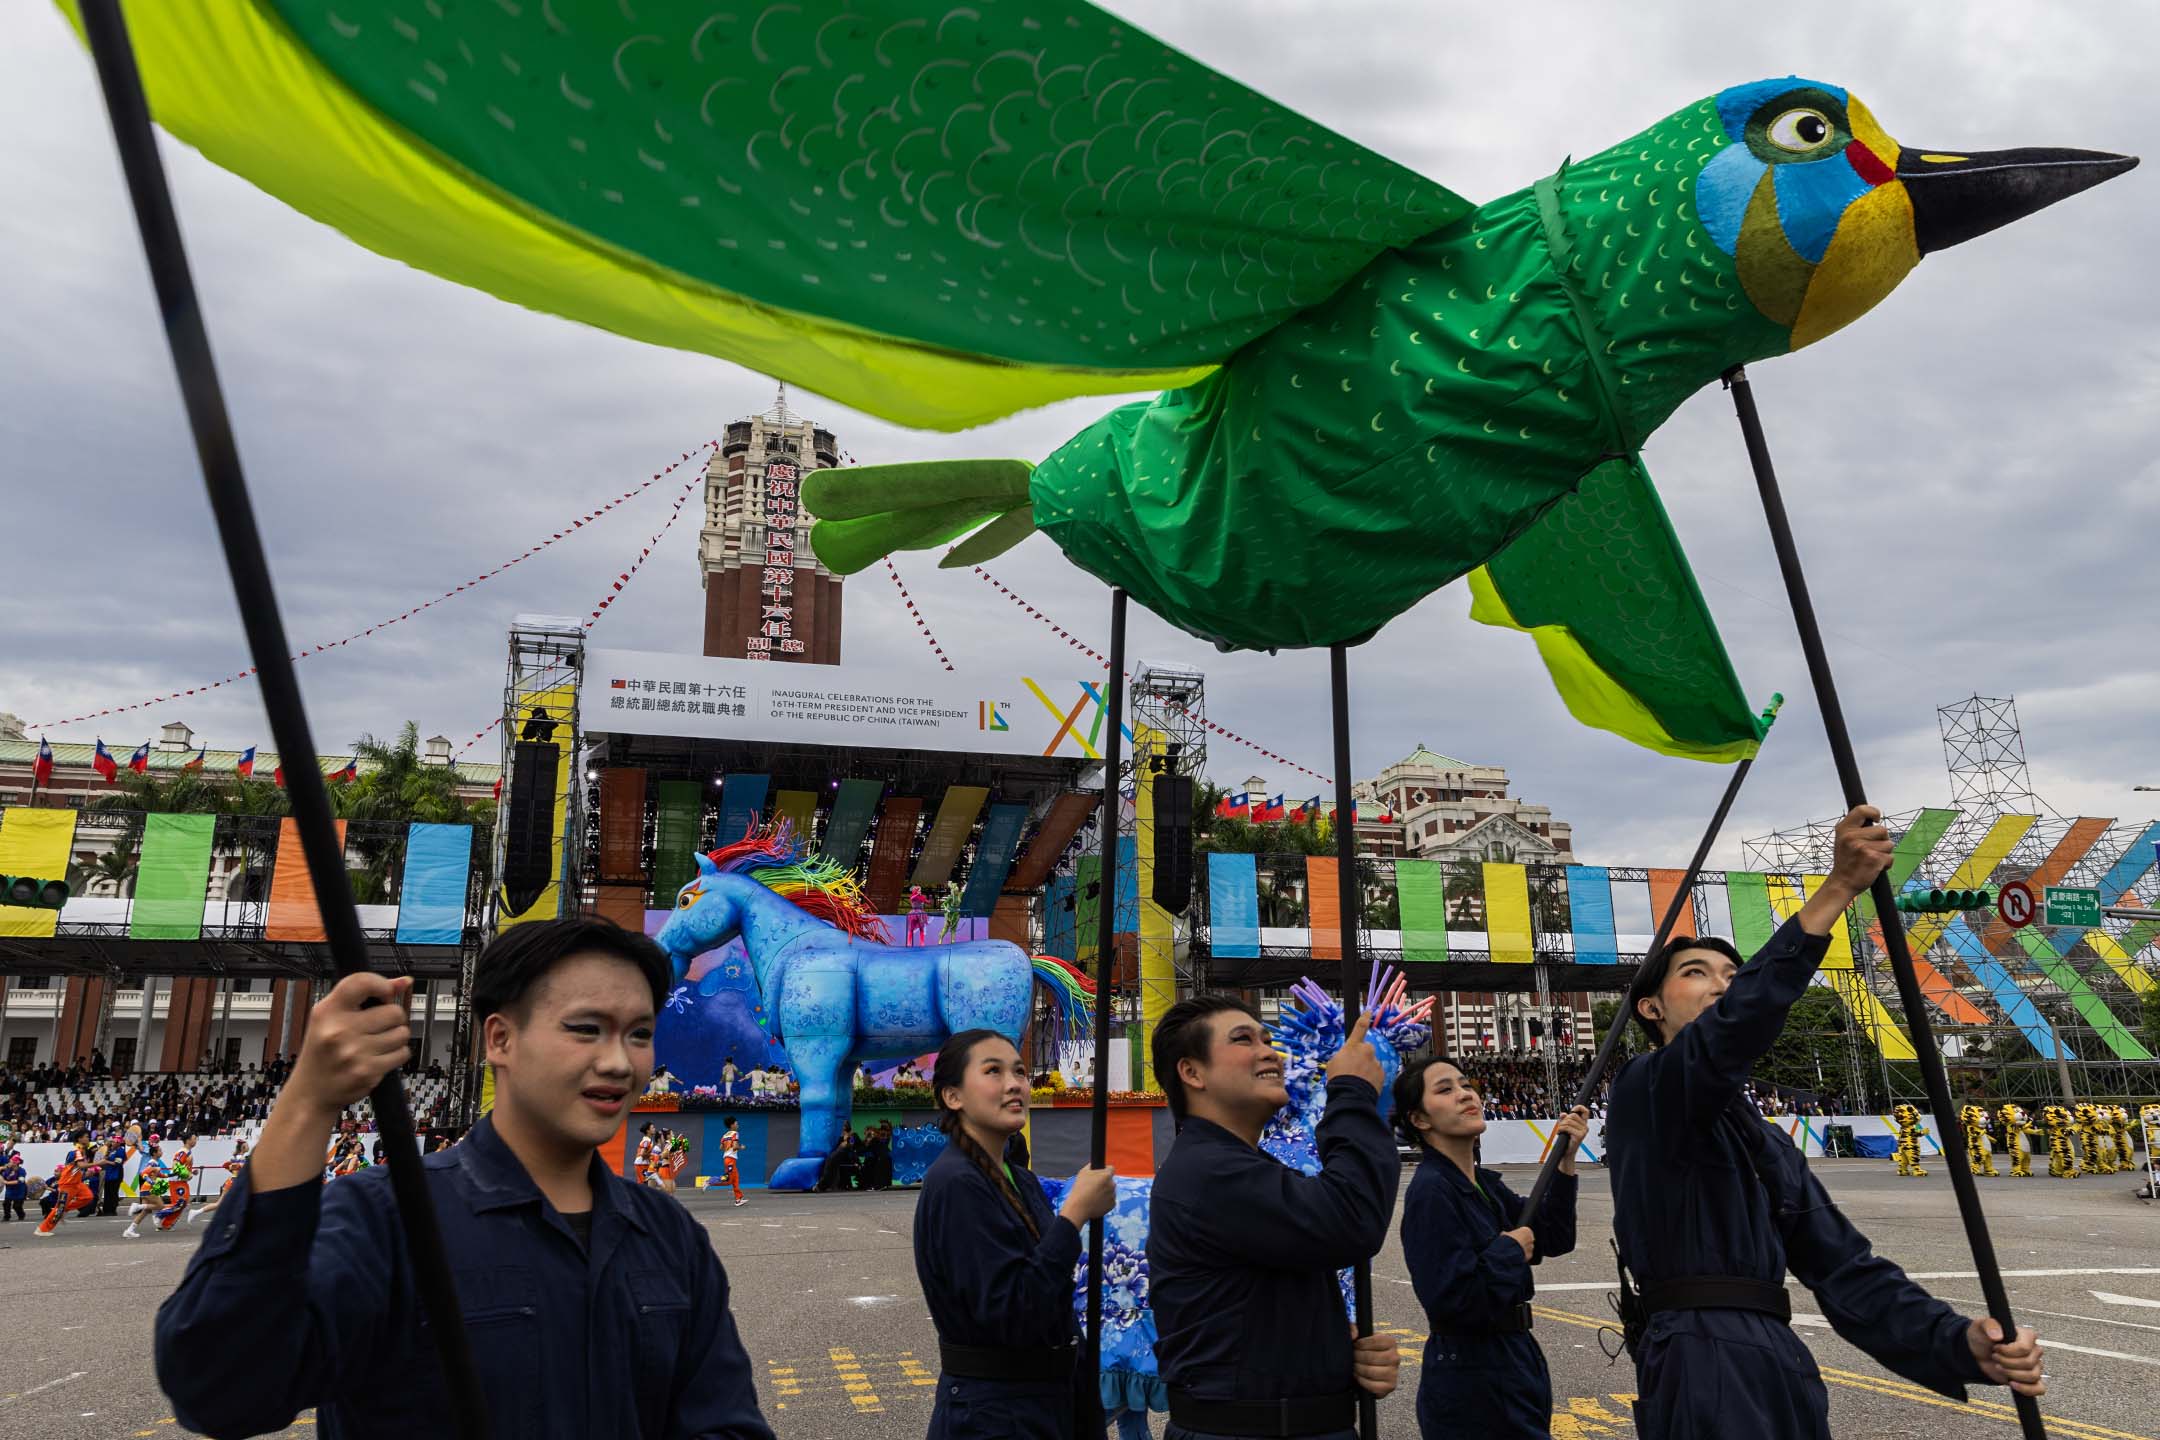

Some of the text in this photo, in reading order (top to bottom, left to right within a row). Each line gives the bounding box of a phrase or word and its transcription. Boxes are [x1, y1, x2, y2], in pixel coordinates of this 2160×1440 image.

[762, 463, 796, 637] 慶祝中華民國第十六任
[627, 679, 747, 699] 中華民國第十六任
[771, 689, 934, 707] INAUGURAL CELEBRATIONS FOR THE
[610, 696, 746, 717] 總統副總統就職典禮
[772, 700, 969, 719] 16TH-TERM PRESIDENT AND VICE PRESIDENT
[770, 710, 940, 728] OF THE REPUBLIC OF CHINA (TAIWAN)
